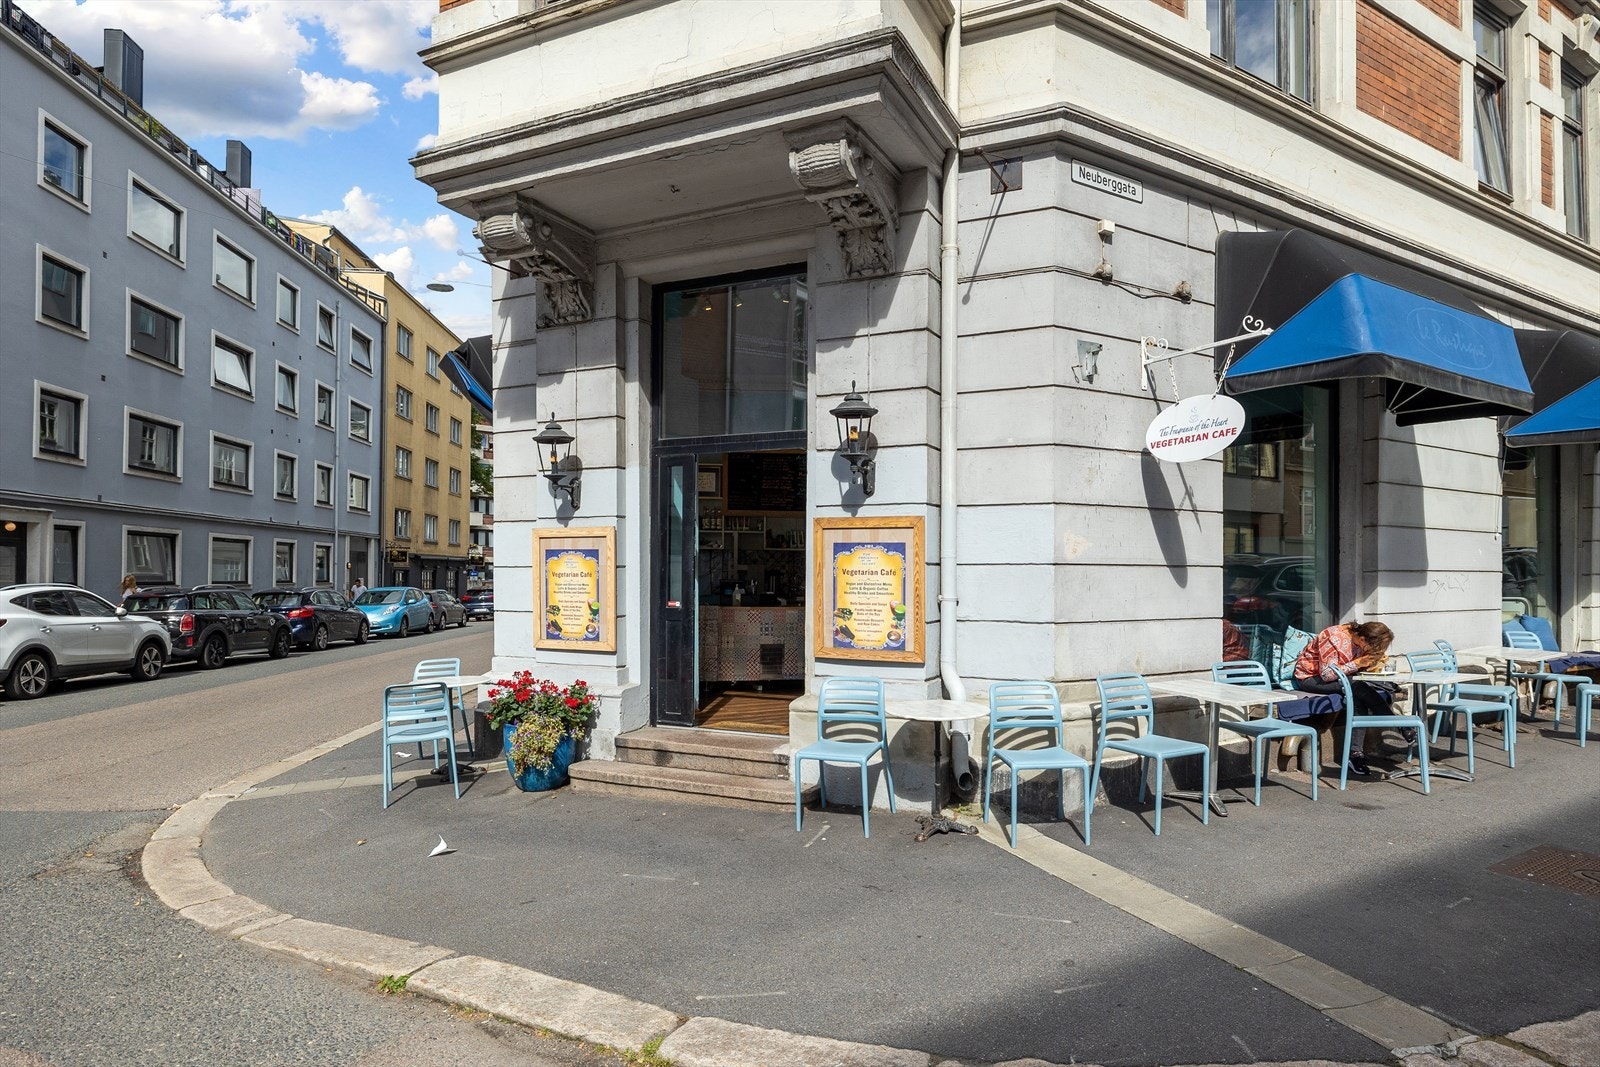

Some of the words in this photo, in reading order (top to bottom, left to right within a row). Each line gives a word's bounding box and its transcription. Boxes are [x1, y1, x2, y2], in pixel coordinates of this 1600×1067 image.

[1079, 166, 1137, 196] Neuberggata
[1150, 432, 1209, 450] VEGETARIAN
[1212, 427, 1238, 439] CAFE
[1160, 426, 1170, 438] The
[1169, 424, 1194, 436] Fragrance
[1194, 420, 1201, 432] of
[1201, 418, 1210, 430] the
[1210, 417, 1229, 427] Heart
[841, 568, 879, 577] Vegetarian
[880, 567, 897, 576] Café
